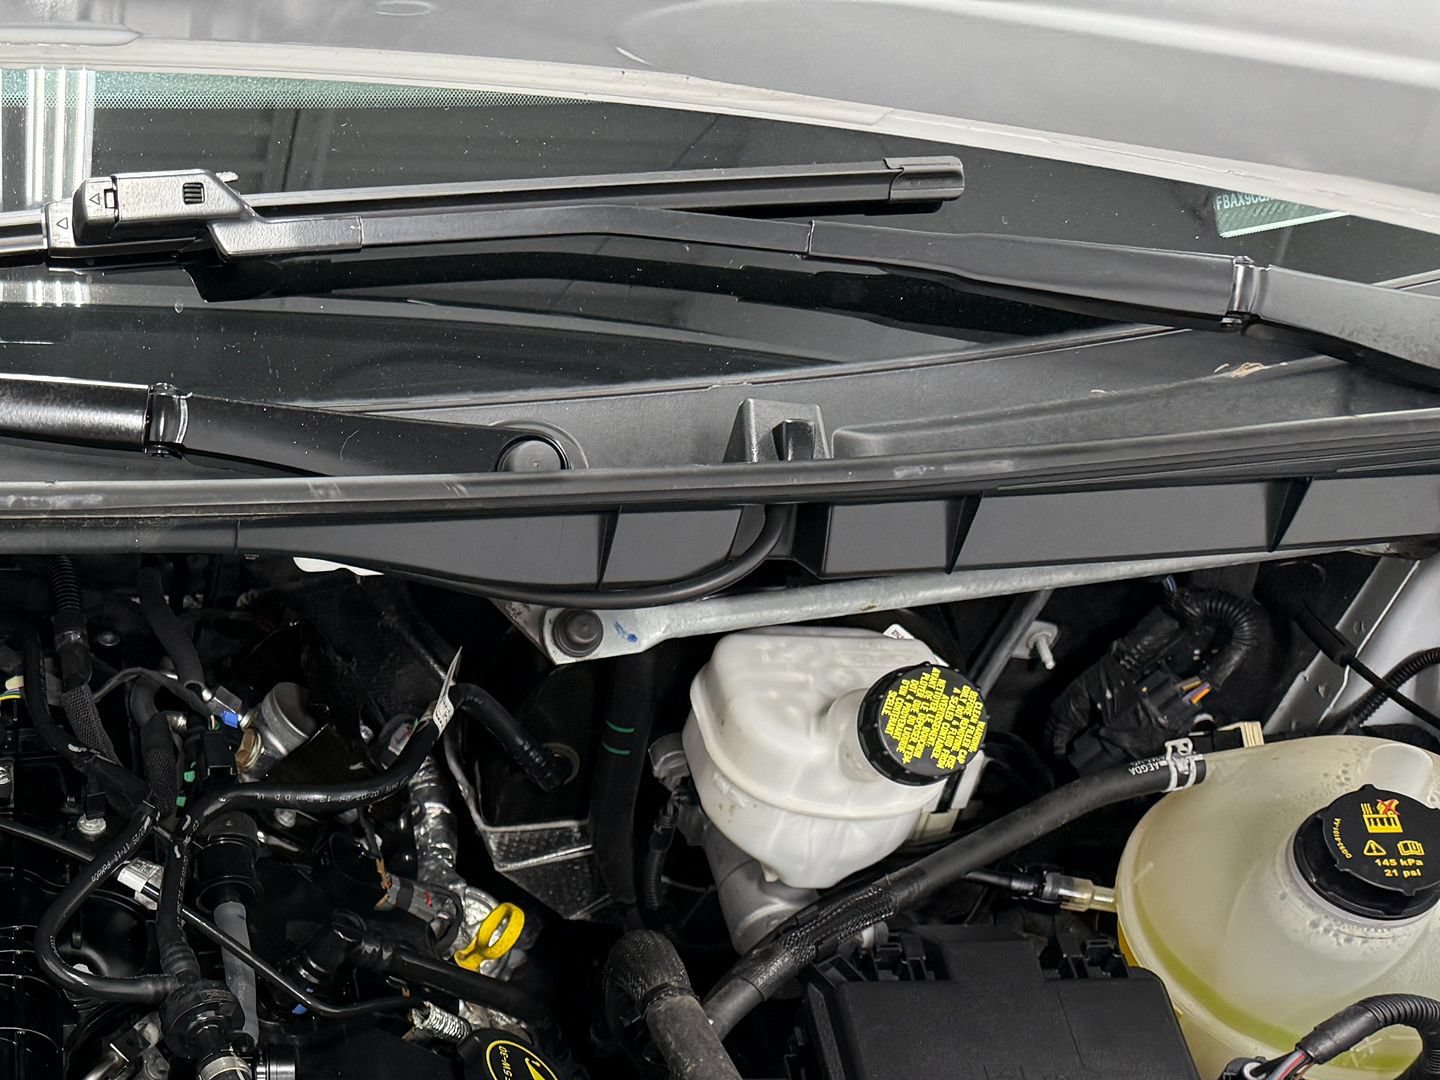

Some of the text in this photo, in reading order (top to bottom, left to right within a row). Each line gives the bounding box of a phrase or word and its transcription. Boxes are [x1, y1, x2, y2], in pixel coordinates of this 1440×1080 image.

[908, 679, 918, 693] DOT
[915, 672, 930, 697] PLOYER
[927, 667, 940, 689] AVANT
[923, 690, 933, 700] DE
[959, 686, 970, 703] ONLY
[963, 691, 978, 716] BEFORE
[885, 697, 903, 736] CONTENANT
[920, 702, 929, 711] LE
[944, 696, 958, 720] SEALED
[954, 705, 964, 718] DOT
[914, 679, 945, 758] NETTOYER LE BOUCHON
[944, 727, 957, 747] FLUID
[956, 702, 983, 764] CLEAN FILLER CAP
[937, 749, 950, 769] FROM
[946, 755, 957, 769] USE
[1375, 858, 1423, 866] 145 kPa
[1384, 868, 1421, 878] 21 psi
[498, 1045, 512, 1077] 5W-30
